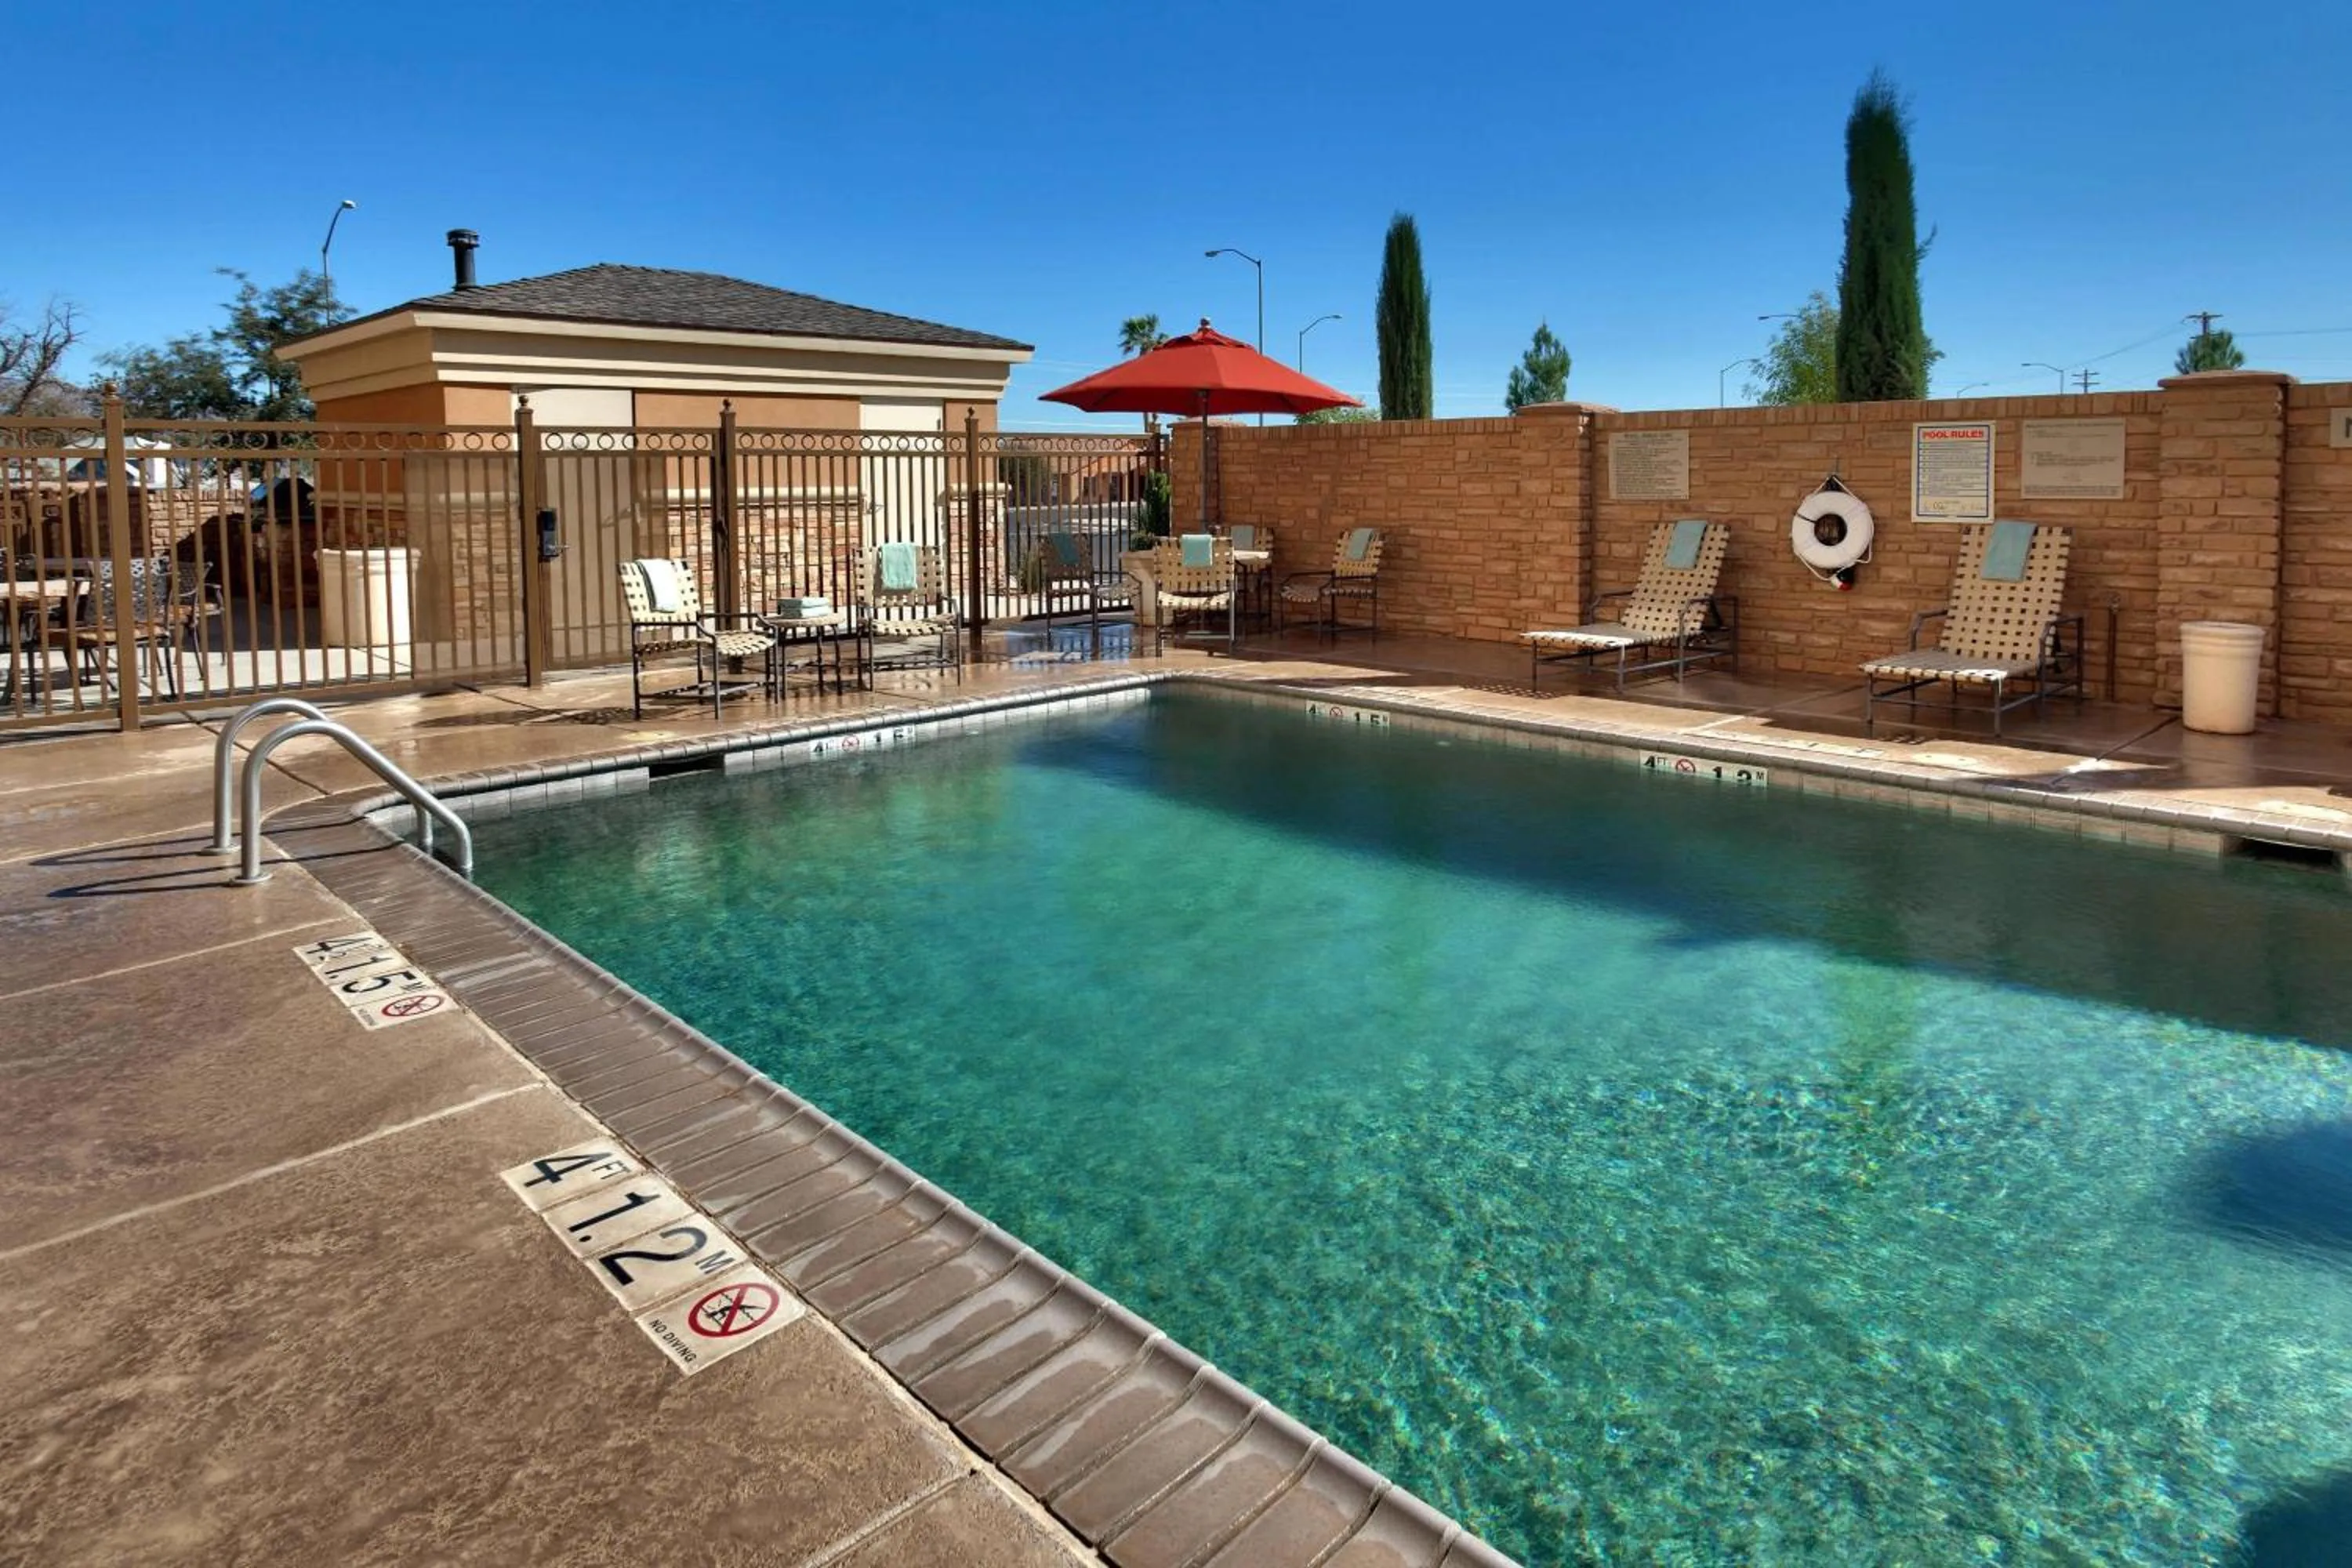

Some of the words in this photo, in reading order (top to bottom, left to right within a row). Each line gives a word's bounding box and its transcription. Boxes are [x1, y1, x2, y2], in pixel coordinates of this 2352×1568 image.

[1951, 429, 1984, 438] RULES
[648, 1319, 668, 1334] NO
[662, 1332, 697, 1363] DIVING
